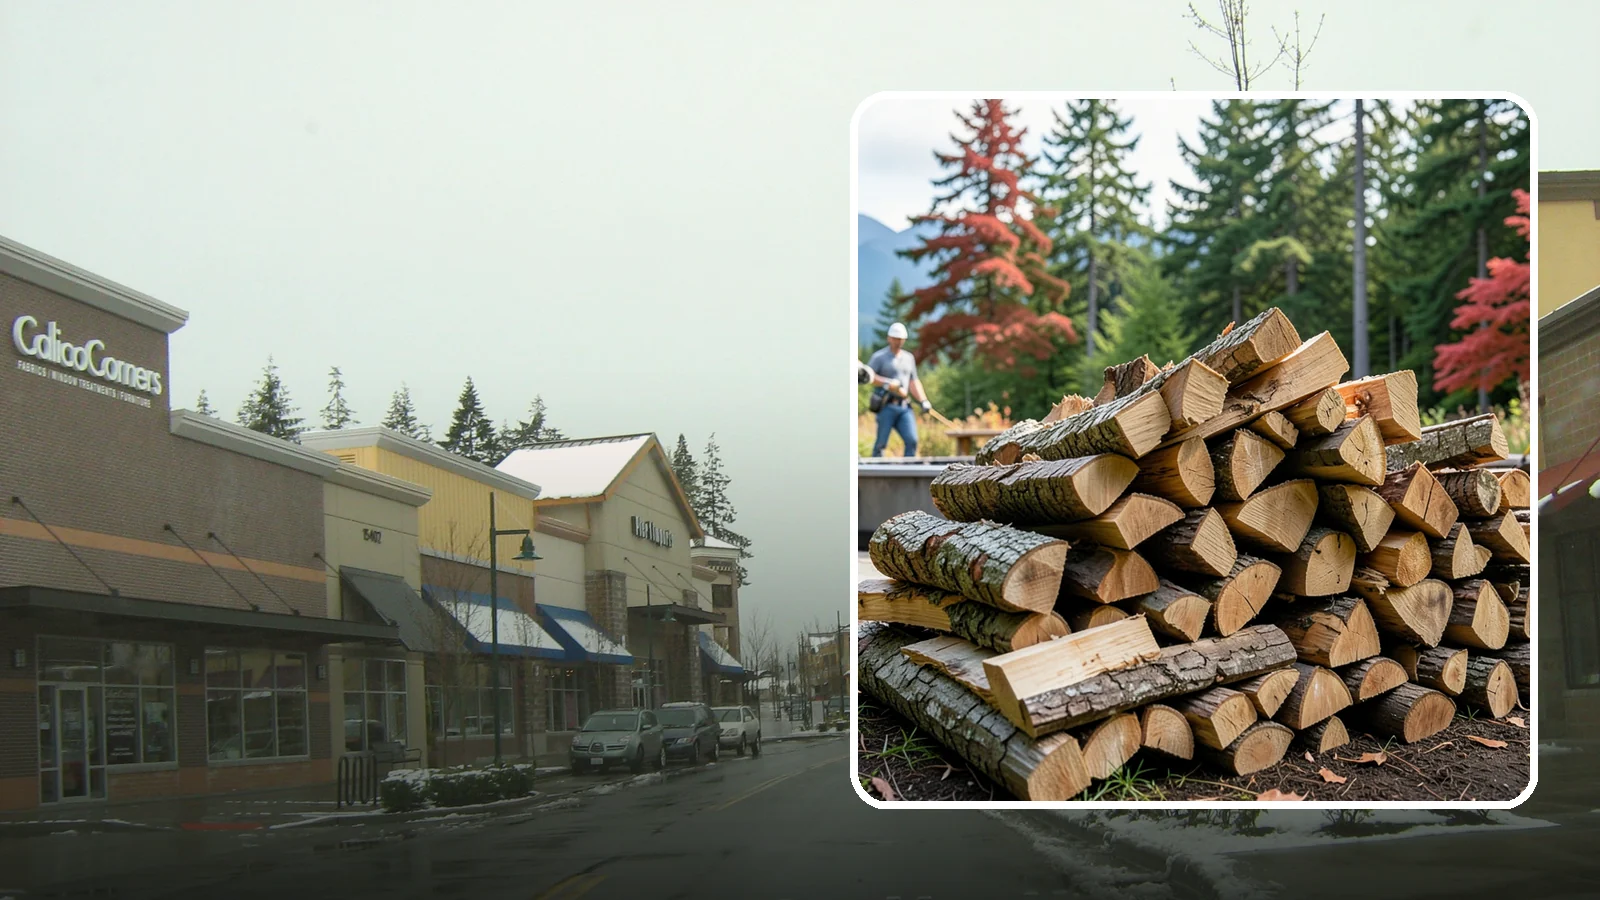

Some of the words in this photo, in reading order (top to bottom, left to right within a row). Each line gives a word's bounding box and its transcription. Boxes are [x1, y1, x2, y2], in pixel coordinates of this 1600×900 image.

[17, 360, 47, 377] FABRICS
[51, 370, 78, 386] WINDOW
[78, 378, 116, 398] TREATMENTS
[120, 391, 151, 408] FURNITURE
